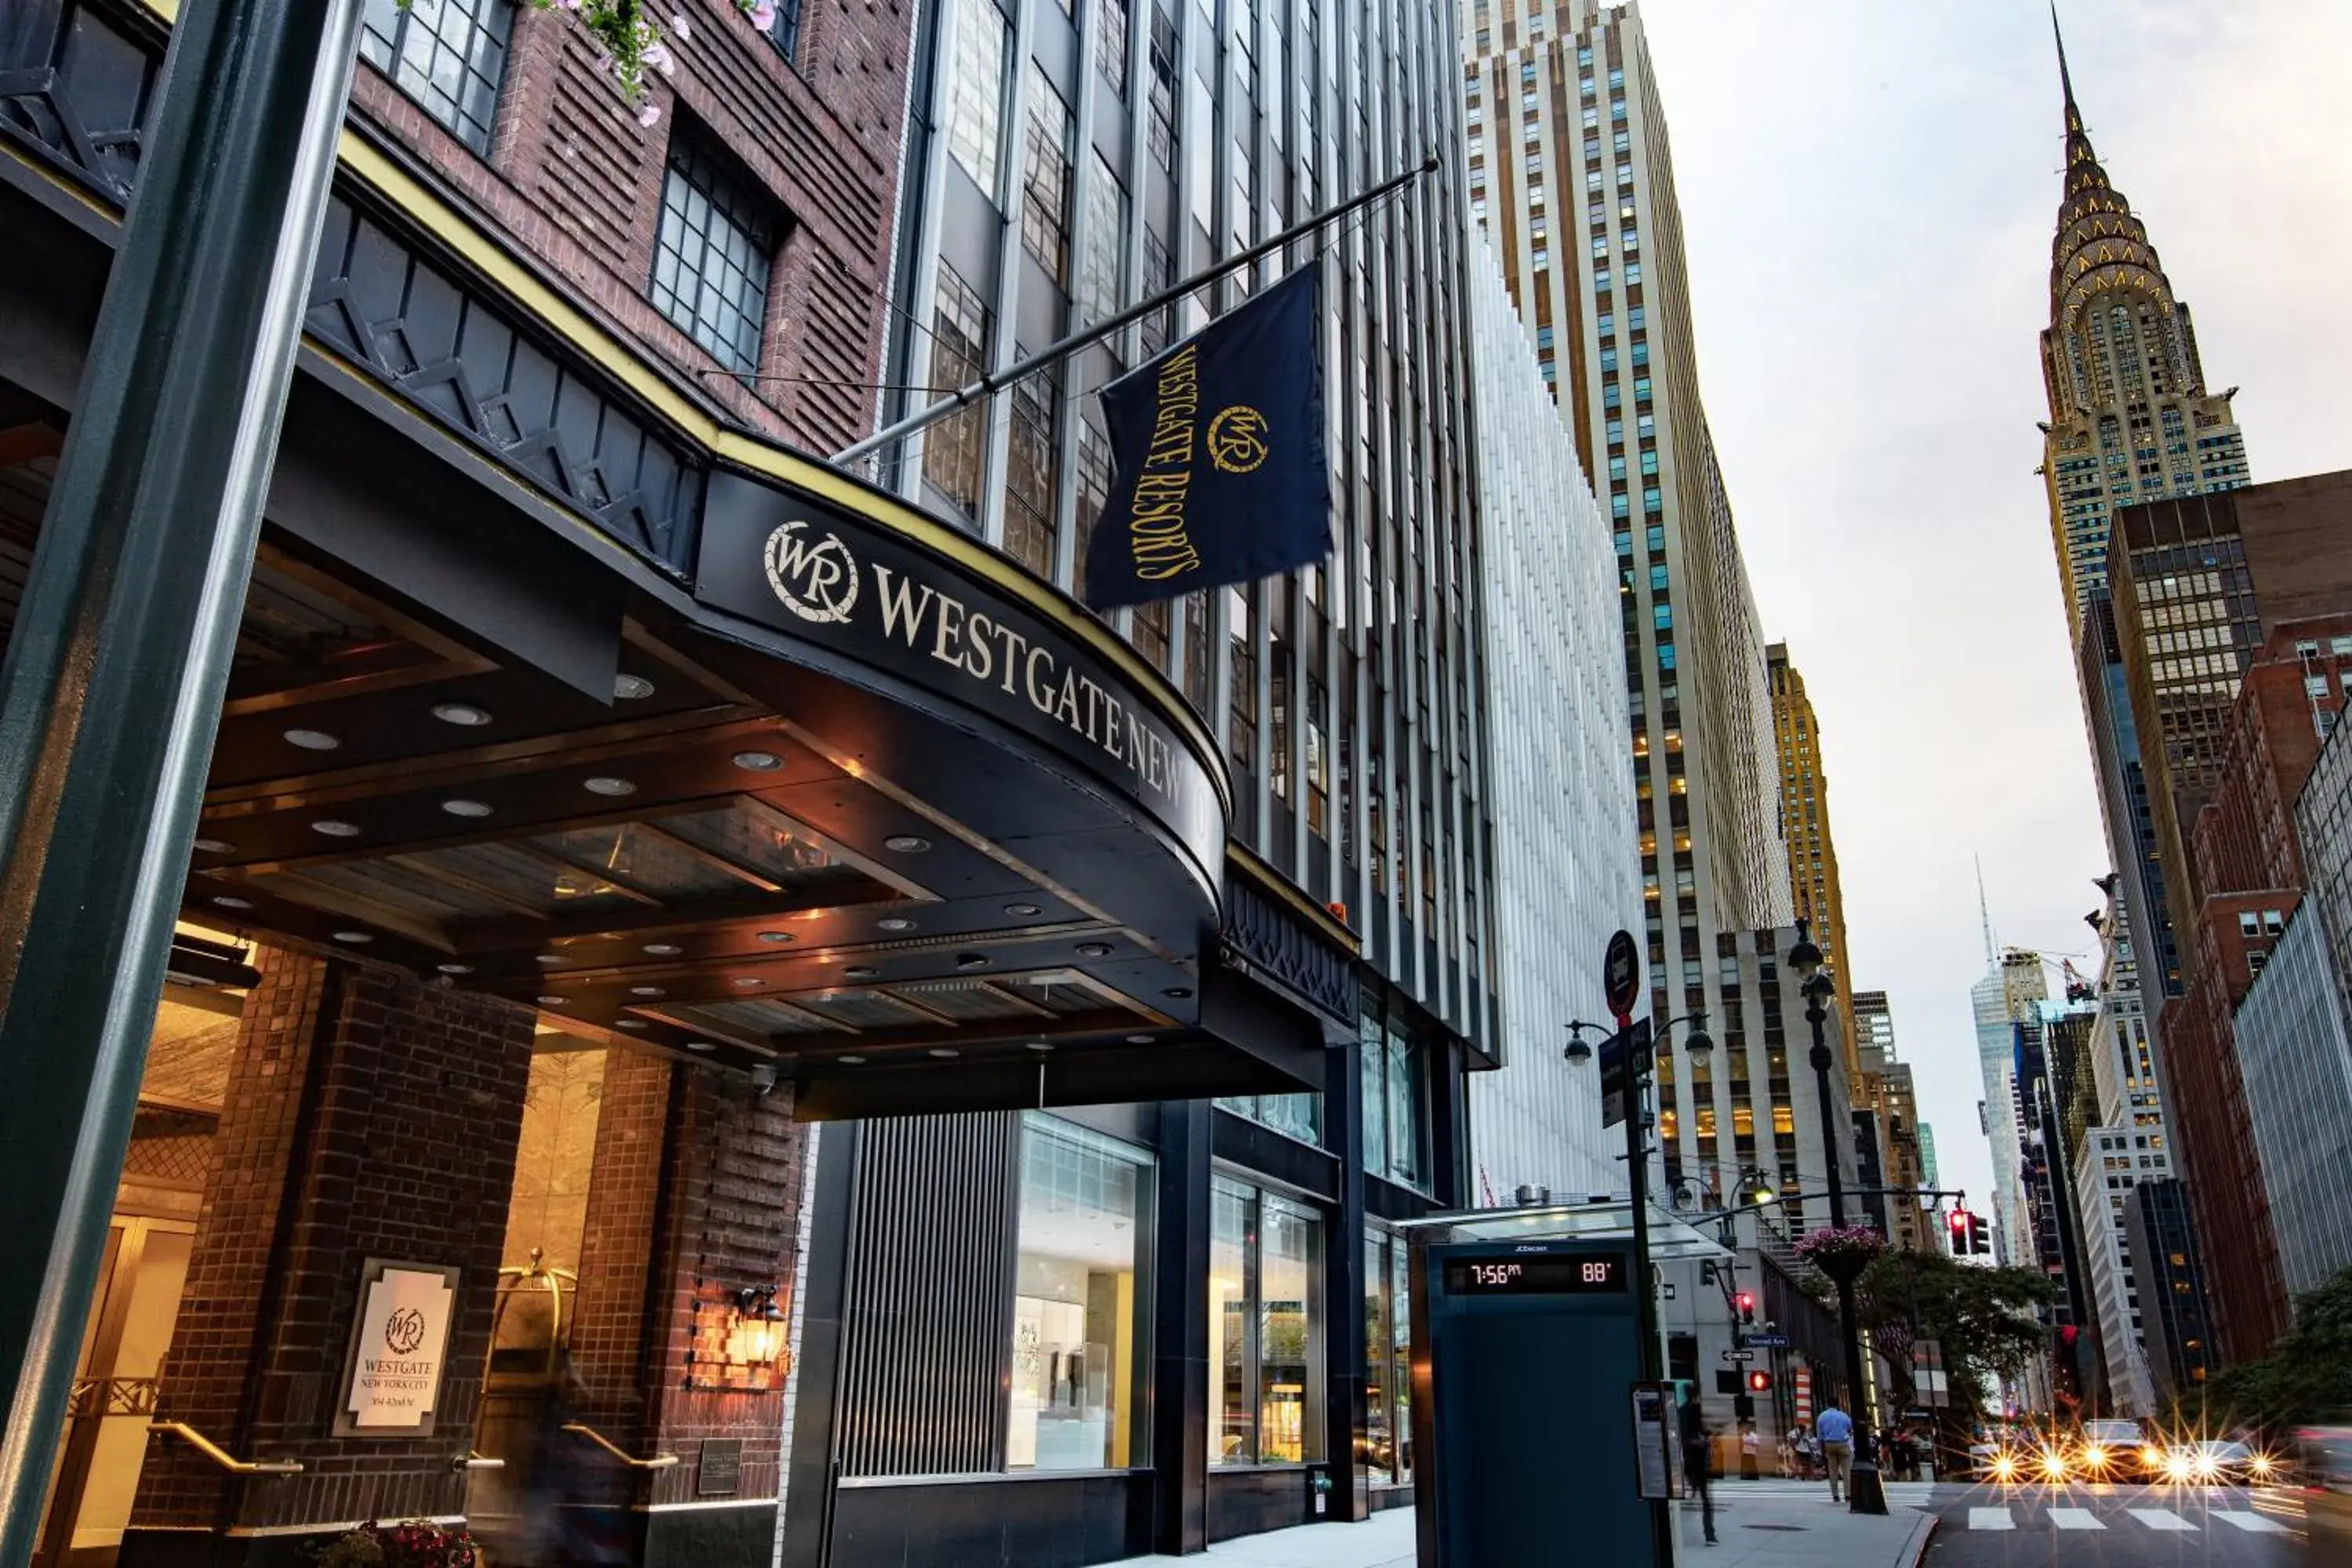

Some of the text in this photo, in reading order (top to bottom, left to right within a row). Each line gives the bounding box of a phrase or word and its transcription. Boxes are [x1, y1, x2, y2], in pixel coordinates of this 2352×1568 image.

[1129, 344, 1202, 580] WESTGATE RESORTS
[871, 561, 1183, 808] WESTGATE NEW
[361, 1379, 381, 1389] NEW
[365, 1358, 434, 1375] WESTGATE
